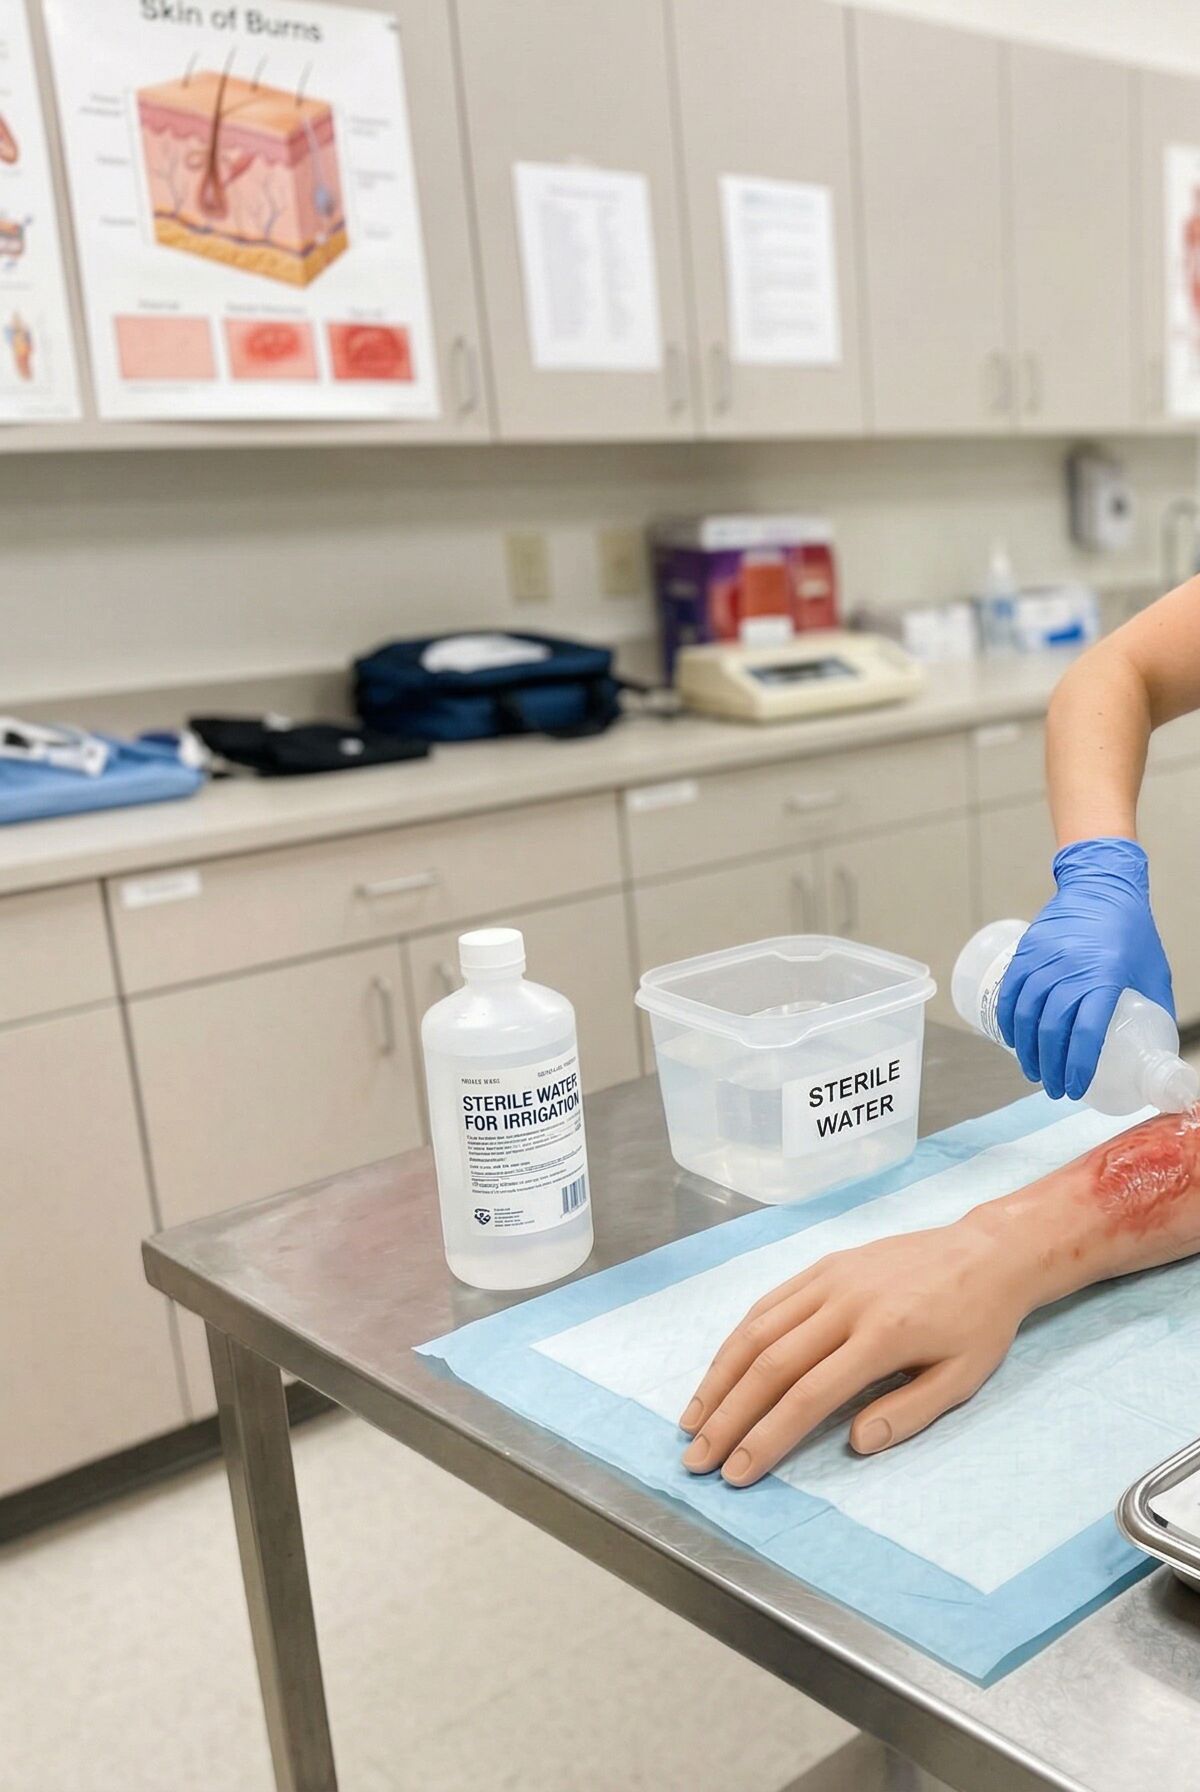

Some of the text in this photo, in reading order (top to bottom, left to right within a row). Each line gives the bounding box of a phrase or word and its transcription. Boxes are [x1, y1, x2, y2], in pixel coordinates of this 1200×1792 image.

[140, 0, 322, 42] Skin of Burns
[462, 1072, 579, 1112] STERILE WATER
[808, 1059, 901, 1108] STERILE
[464, 1090, 580, 1131] FOR IRRIGATION
[816, 1093, 895, 1138] WATER
